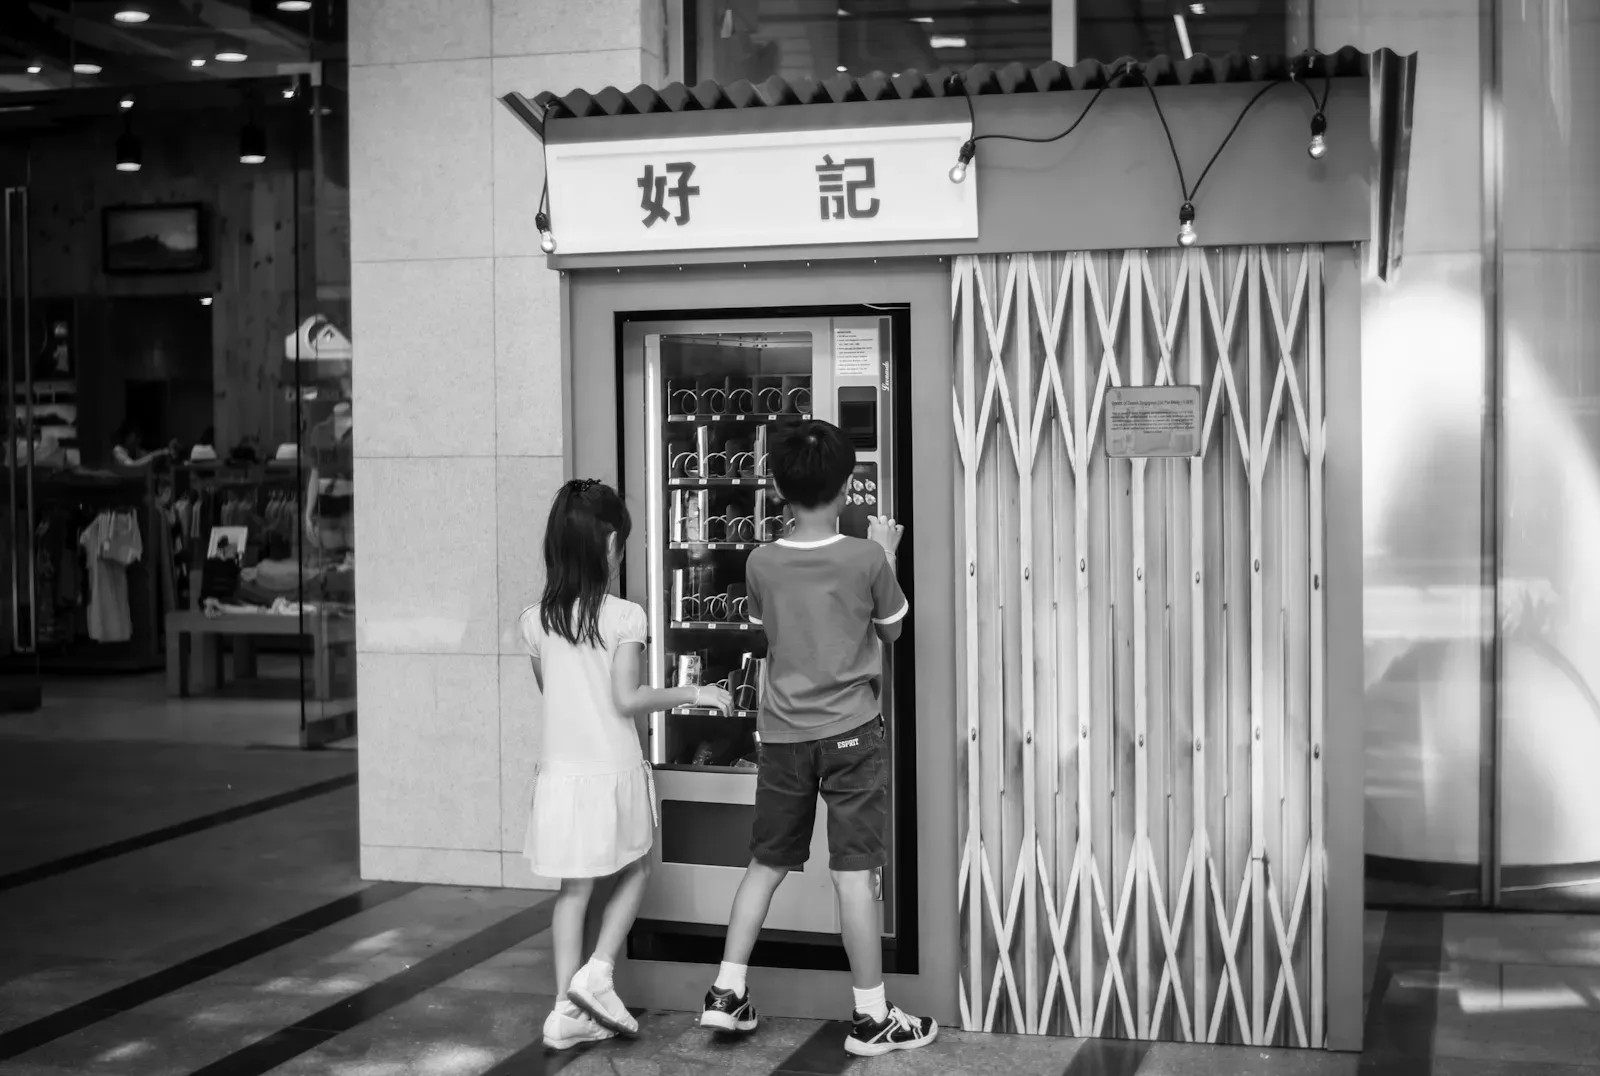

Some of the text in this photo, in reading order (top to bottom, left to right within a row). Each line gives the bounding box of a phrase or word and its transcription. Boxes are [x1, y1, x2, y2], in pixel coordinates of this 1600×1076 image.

[637, 154, 880, 229] 好 記
[837, 738, 859, 749] ESPRIT
